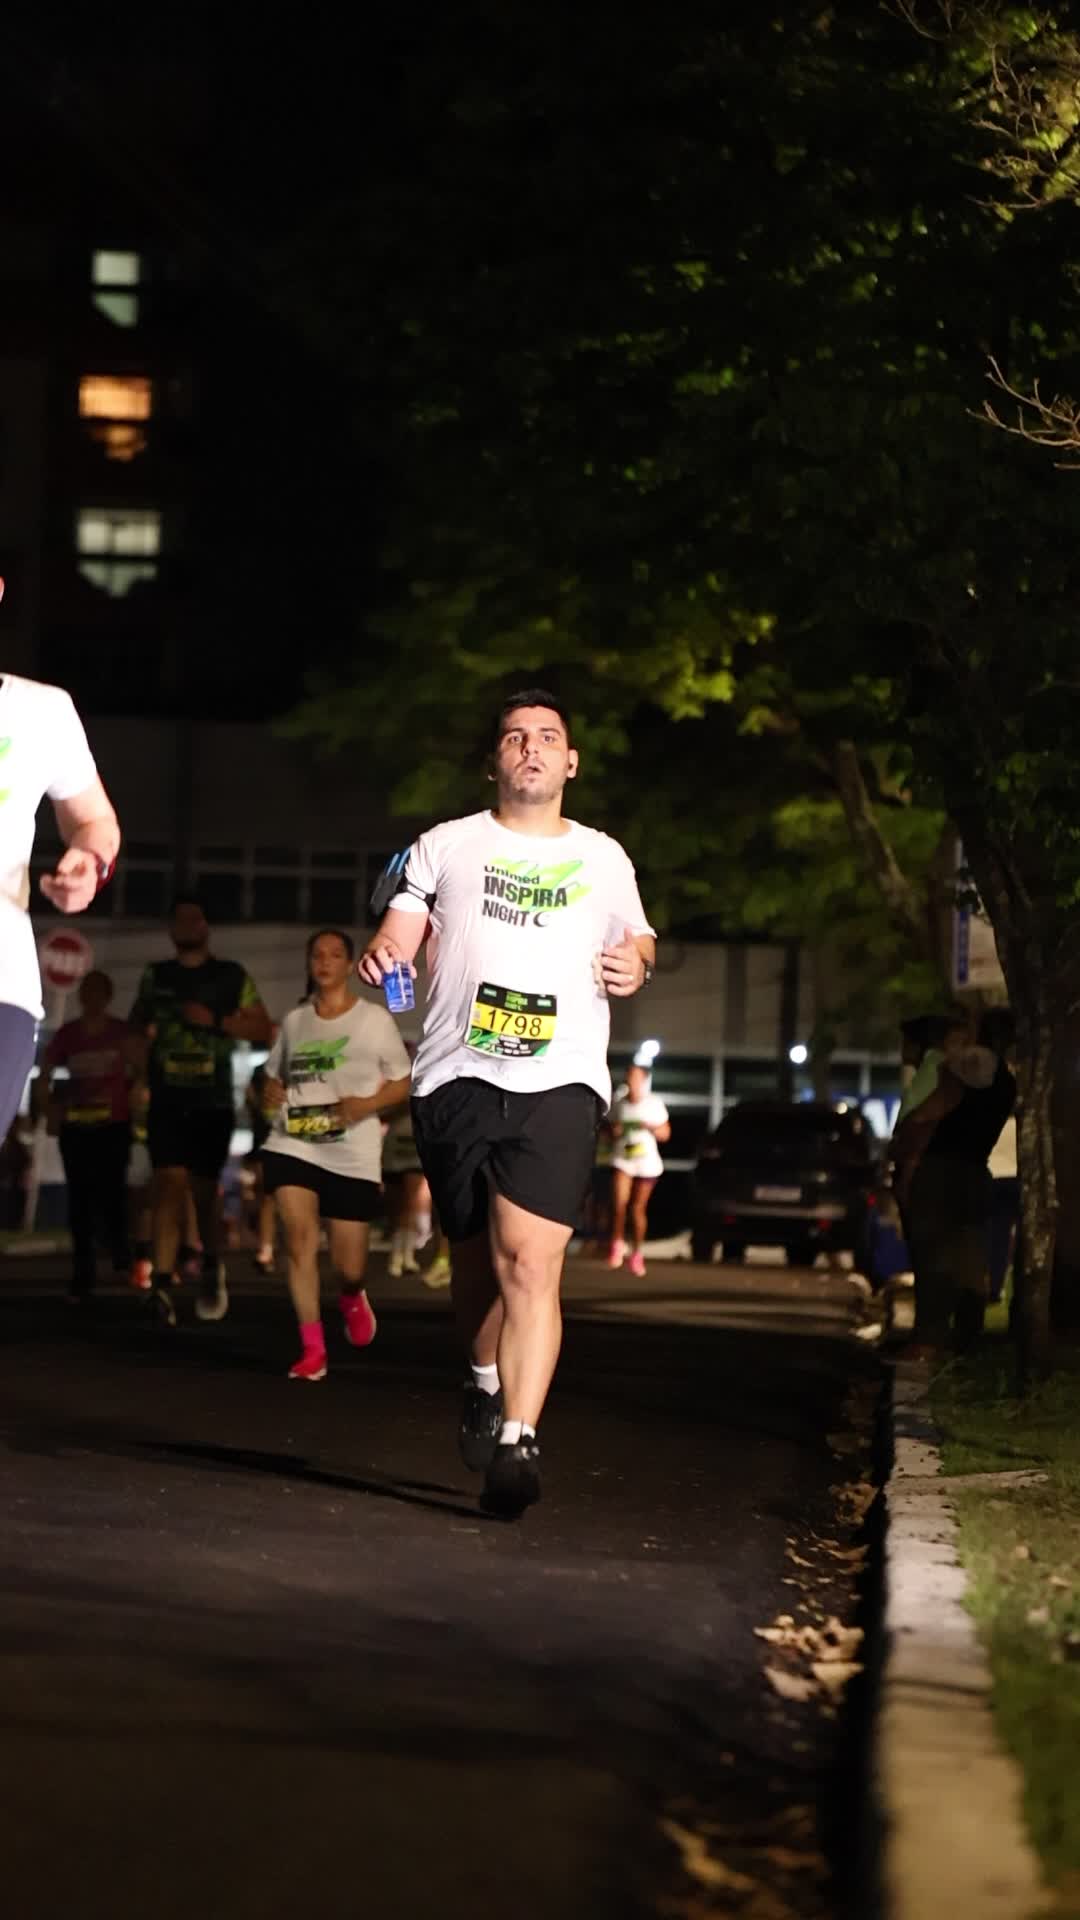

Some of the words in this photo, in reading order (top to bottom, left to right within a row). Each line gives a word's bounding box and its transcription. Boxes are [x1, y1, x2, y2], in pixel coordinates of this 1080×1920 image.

[484, 864, 540, 885] Unimed
[484, 875, 568, 907] INSPIRA
[482, 898, 530, 927] NIGHT
[488, 1009, 542, 1037] 1798
